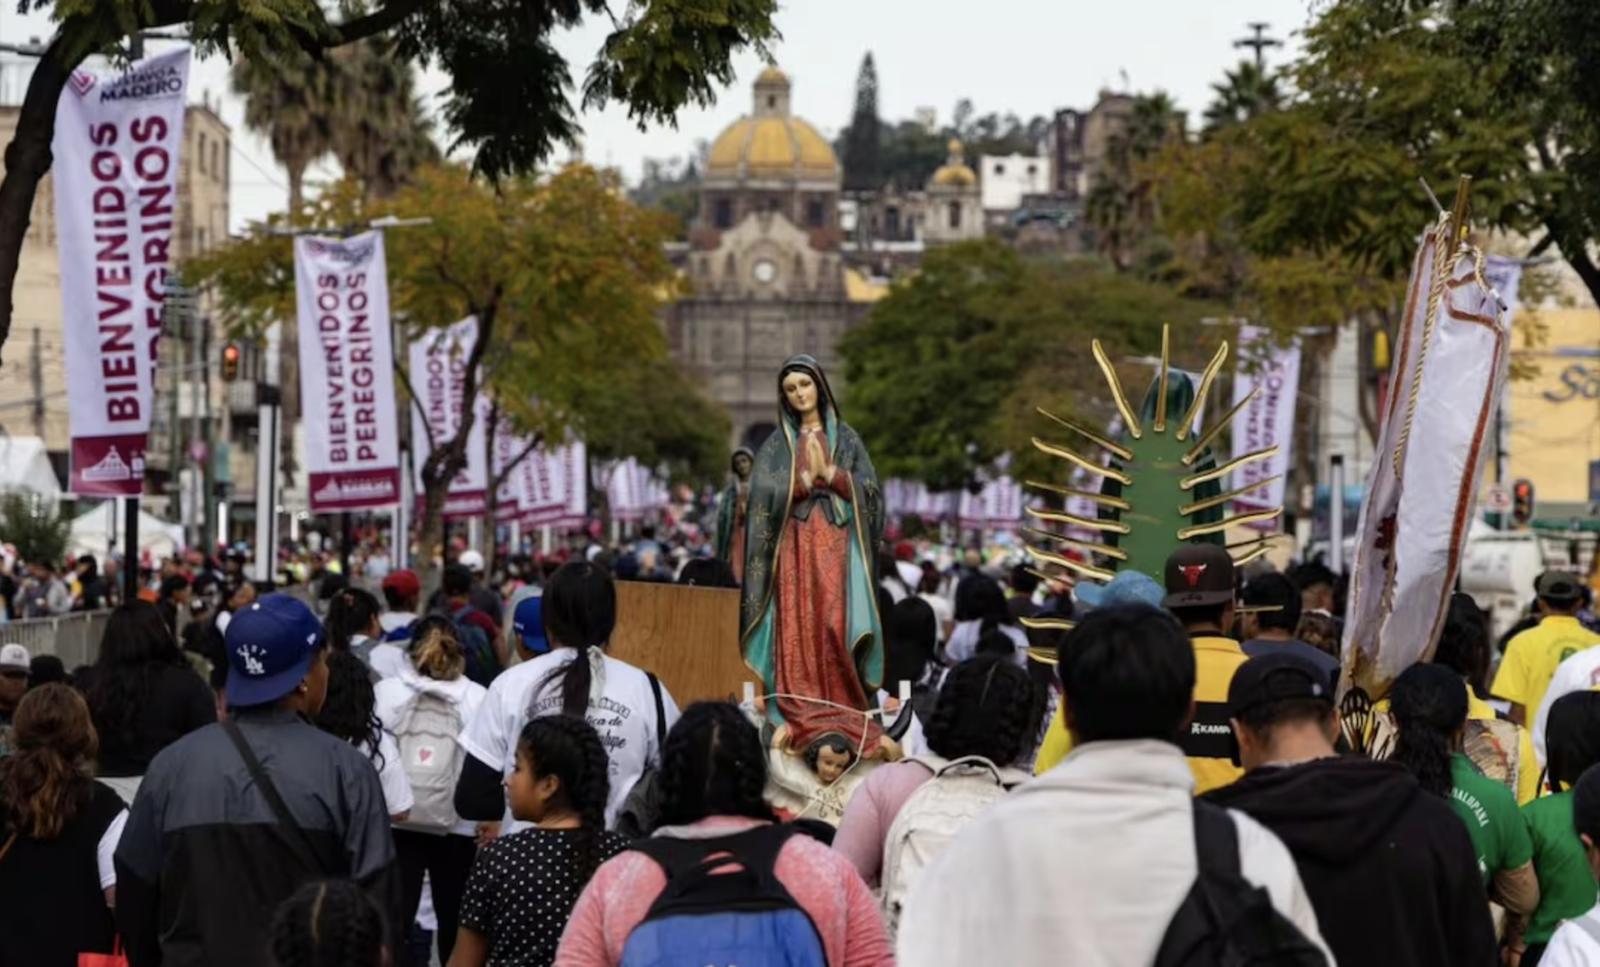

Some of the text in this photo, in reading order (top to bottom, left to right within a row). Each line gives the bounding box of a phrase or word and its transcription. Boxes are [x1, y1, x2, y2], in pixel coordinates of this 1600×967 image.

[100, 77, 182, 104] MADERO
[89, 122, 140, 422] BIENVENIDOS
[346, 271, 378, 462] PEREGRINOS
[318, 273, 348, 464] BIENVENIDOS
